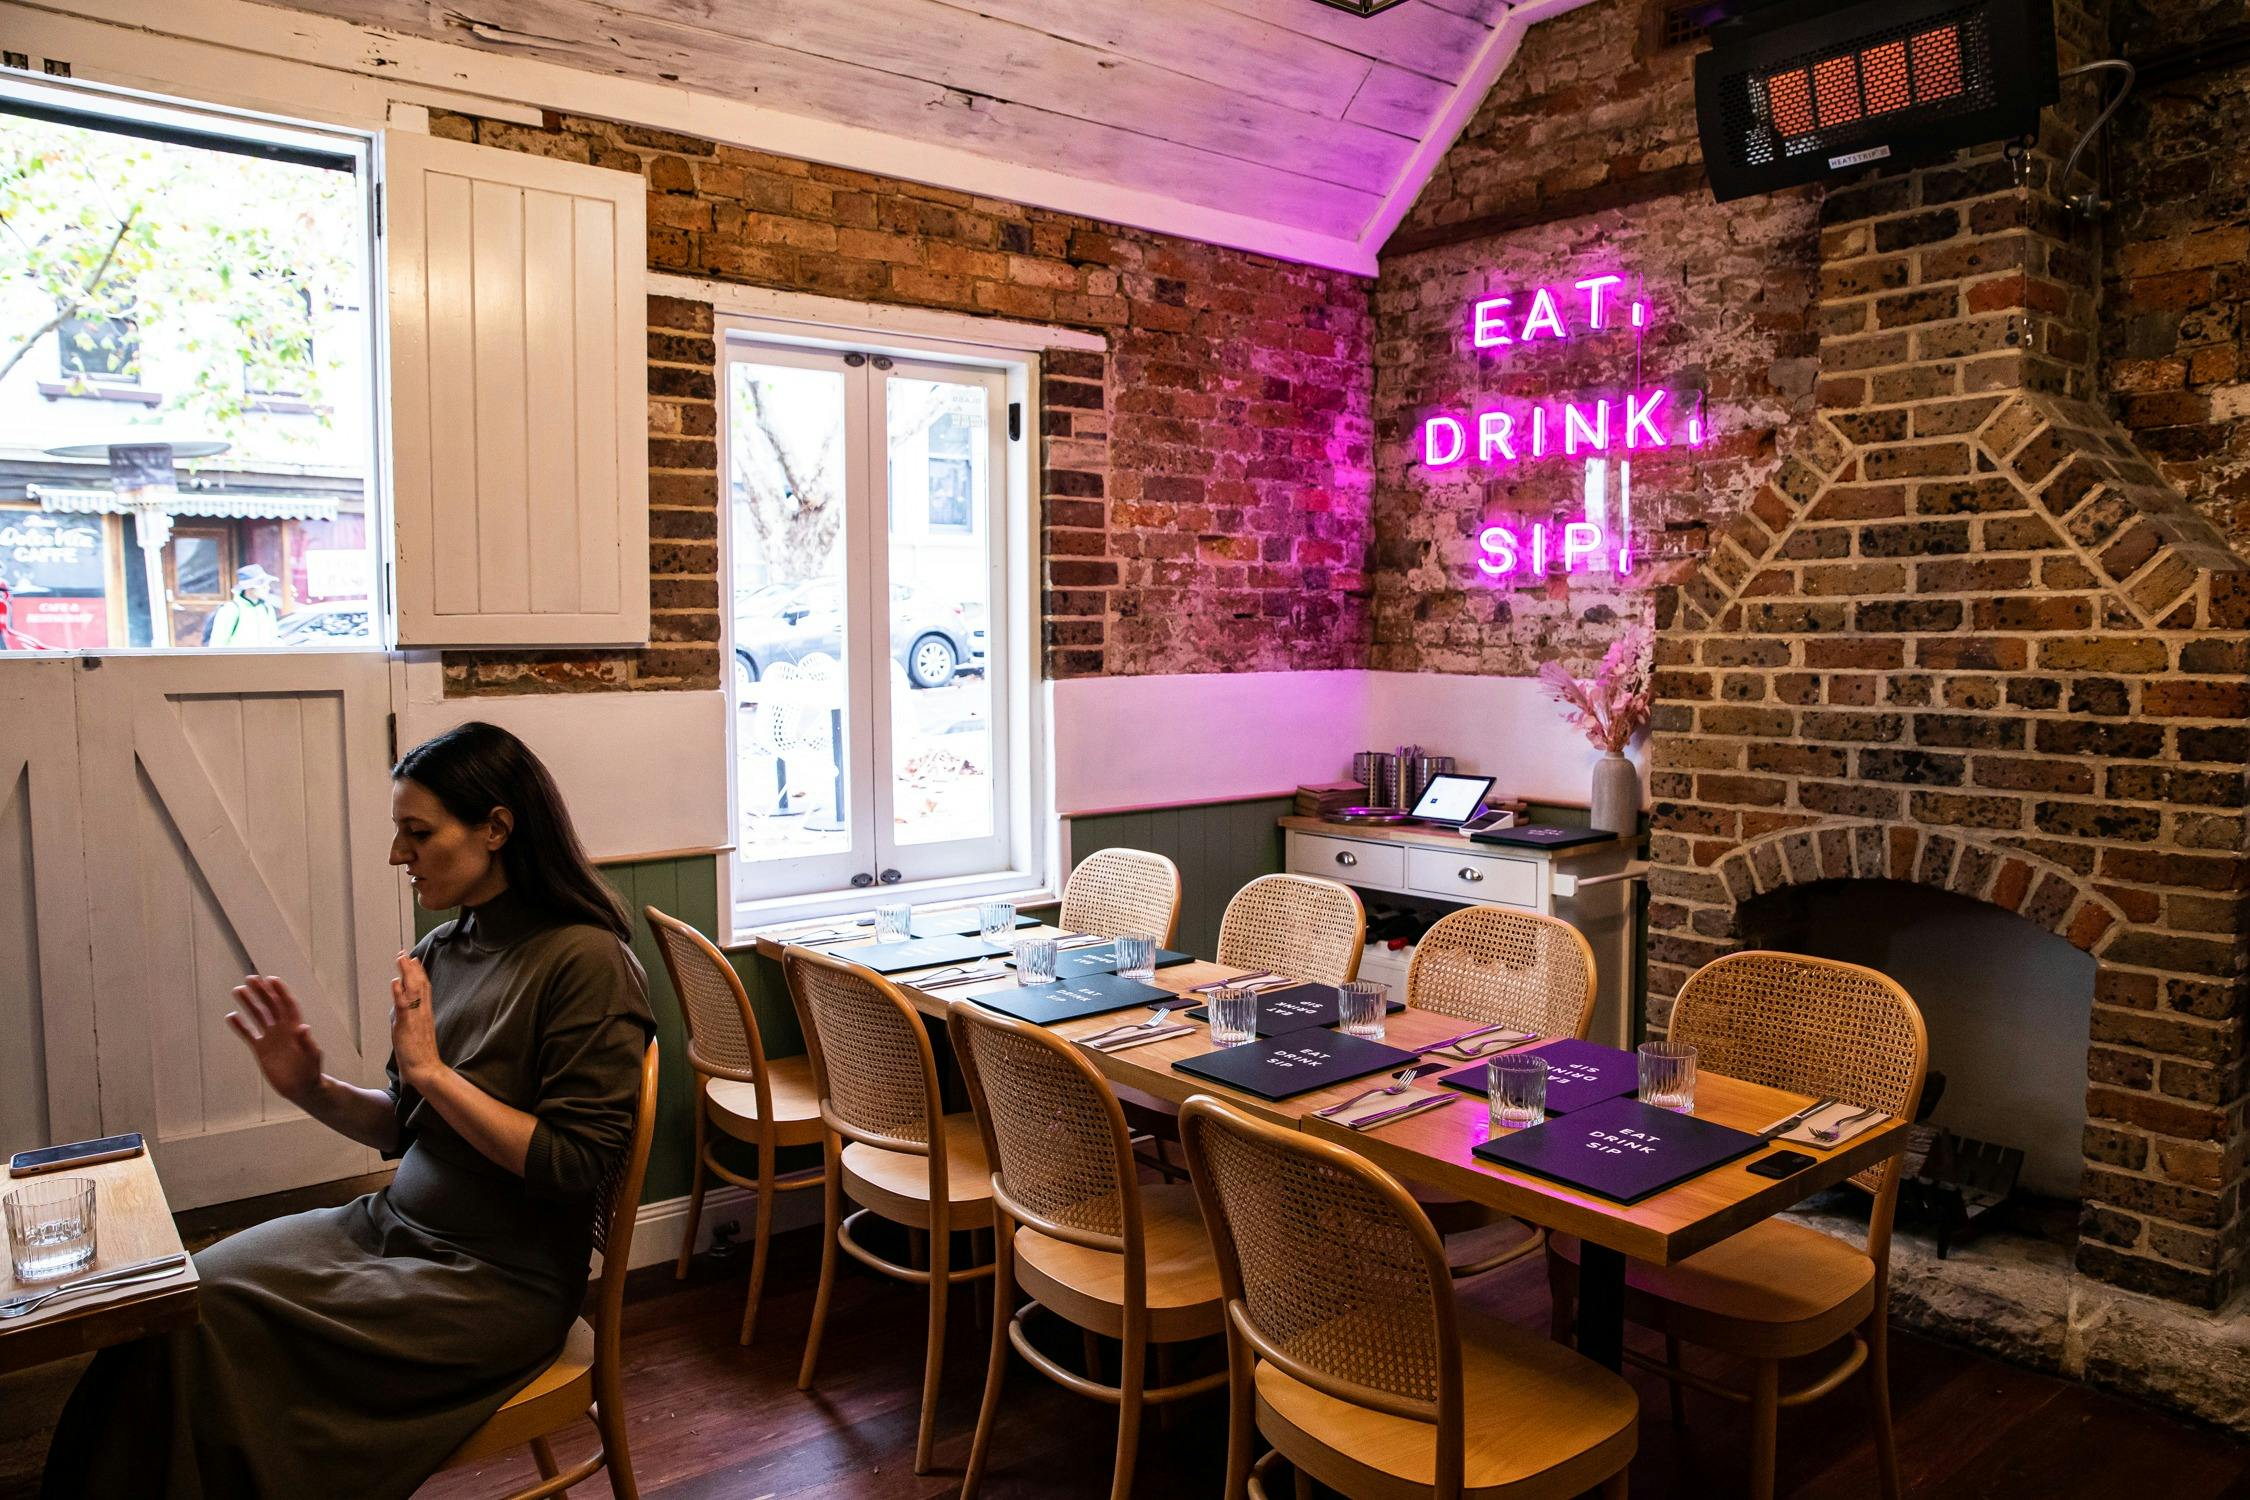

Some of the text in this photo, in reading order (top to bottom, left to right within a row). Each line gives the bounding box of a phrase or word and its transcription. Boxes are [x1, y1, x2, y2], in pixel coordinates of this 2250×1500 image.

[1831, 151, 1877, 166] HEATSTRIP
[1274, 1050, 1322, 1067] DRINK
[1299, 1048, 1331, 1059] EAT
[1266, 1058, 1294, 1067] SIP
[1569, 1064, 1600, 1073] SIP
[1547, 1075, 1571, 1083] EA
[1618, 1128, 1661, 1142] EAT
[1586, 1142, 1622, 1154] SIP
[1588, 1130, 1657, 1154] DRINK
